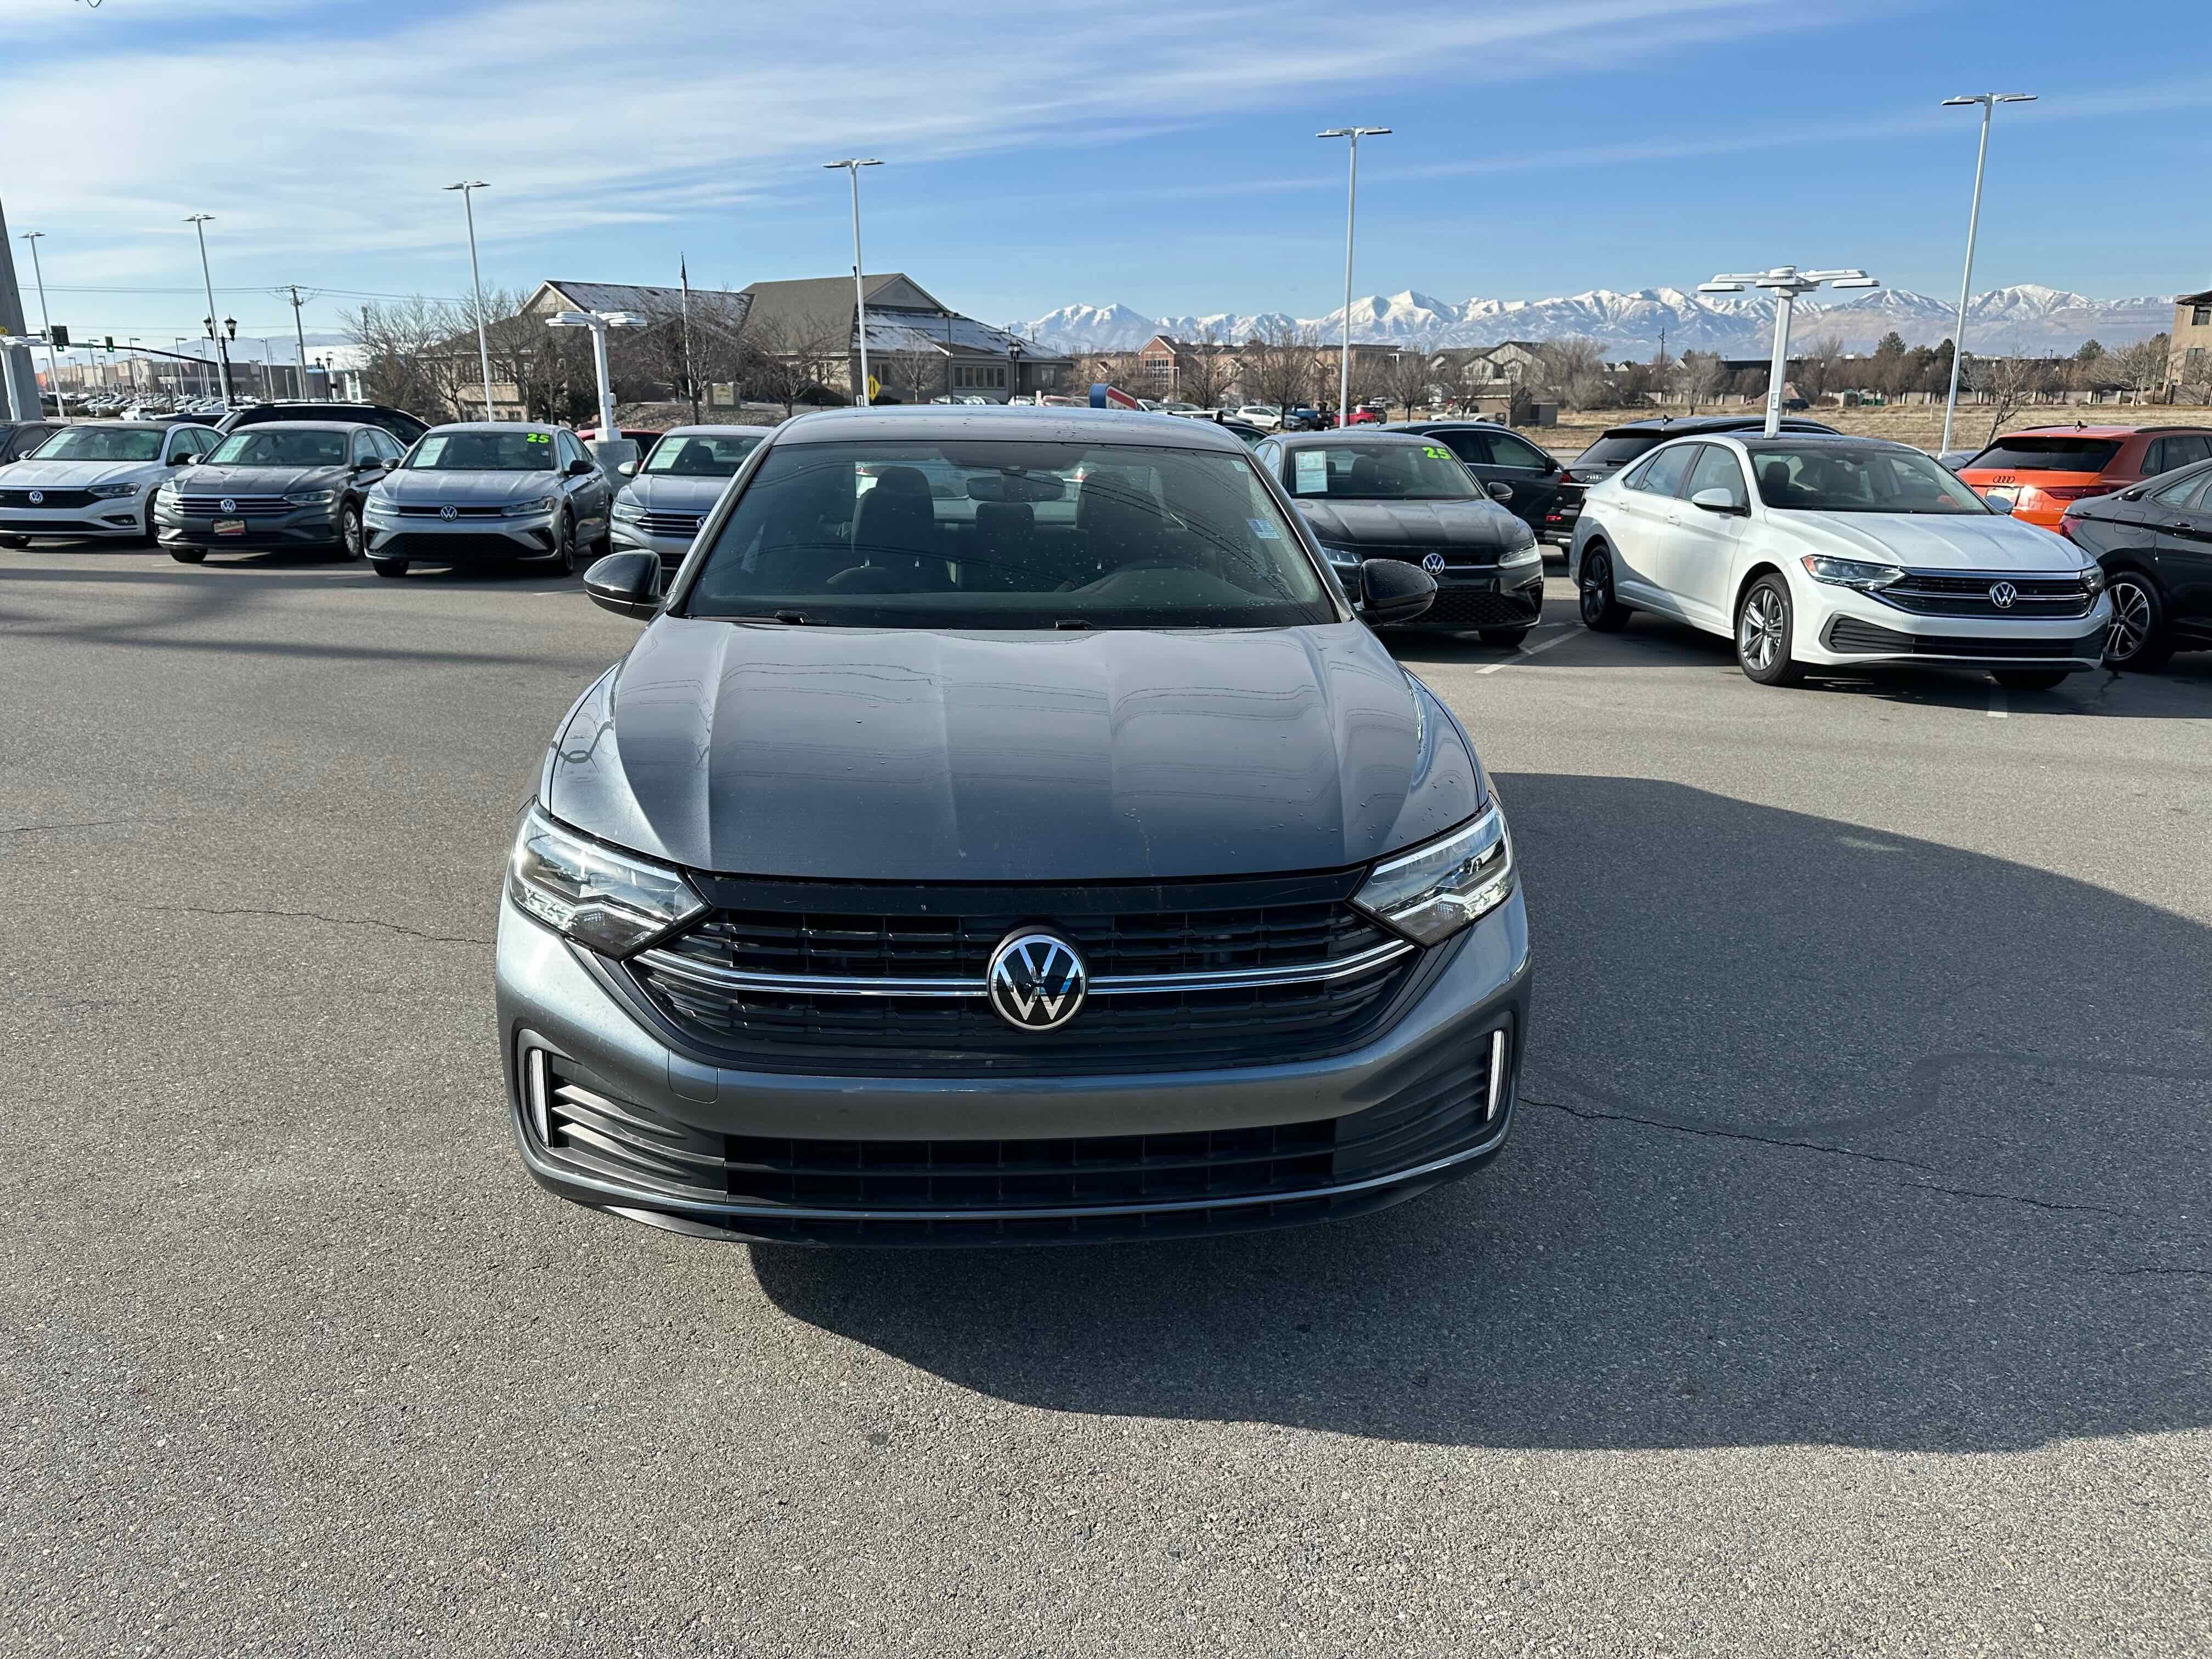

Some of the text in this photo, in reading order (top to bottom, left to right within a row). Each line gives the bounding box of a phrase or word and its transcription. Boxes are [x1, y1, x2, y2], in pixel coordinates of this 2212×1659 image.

[527, 433, 549, 444] 25
[1422, 447, 1451, 460] 25
[441, 505, 456, 520] VW
[1423, 553, 1444, 574] VW
[1990, 582, 2016, 608] VW
[988, 934, 1086, 1029] VW
